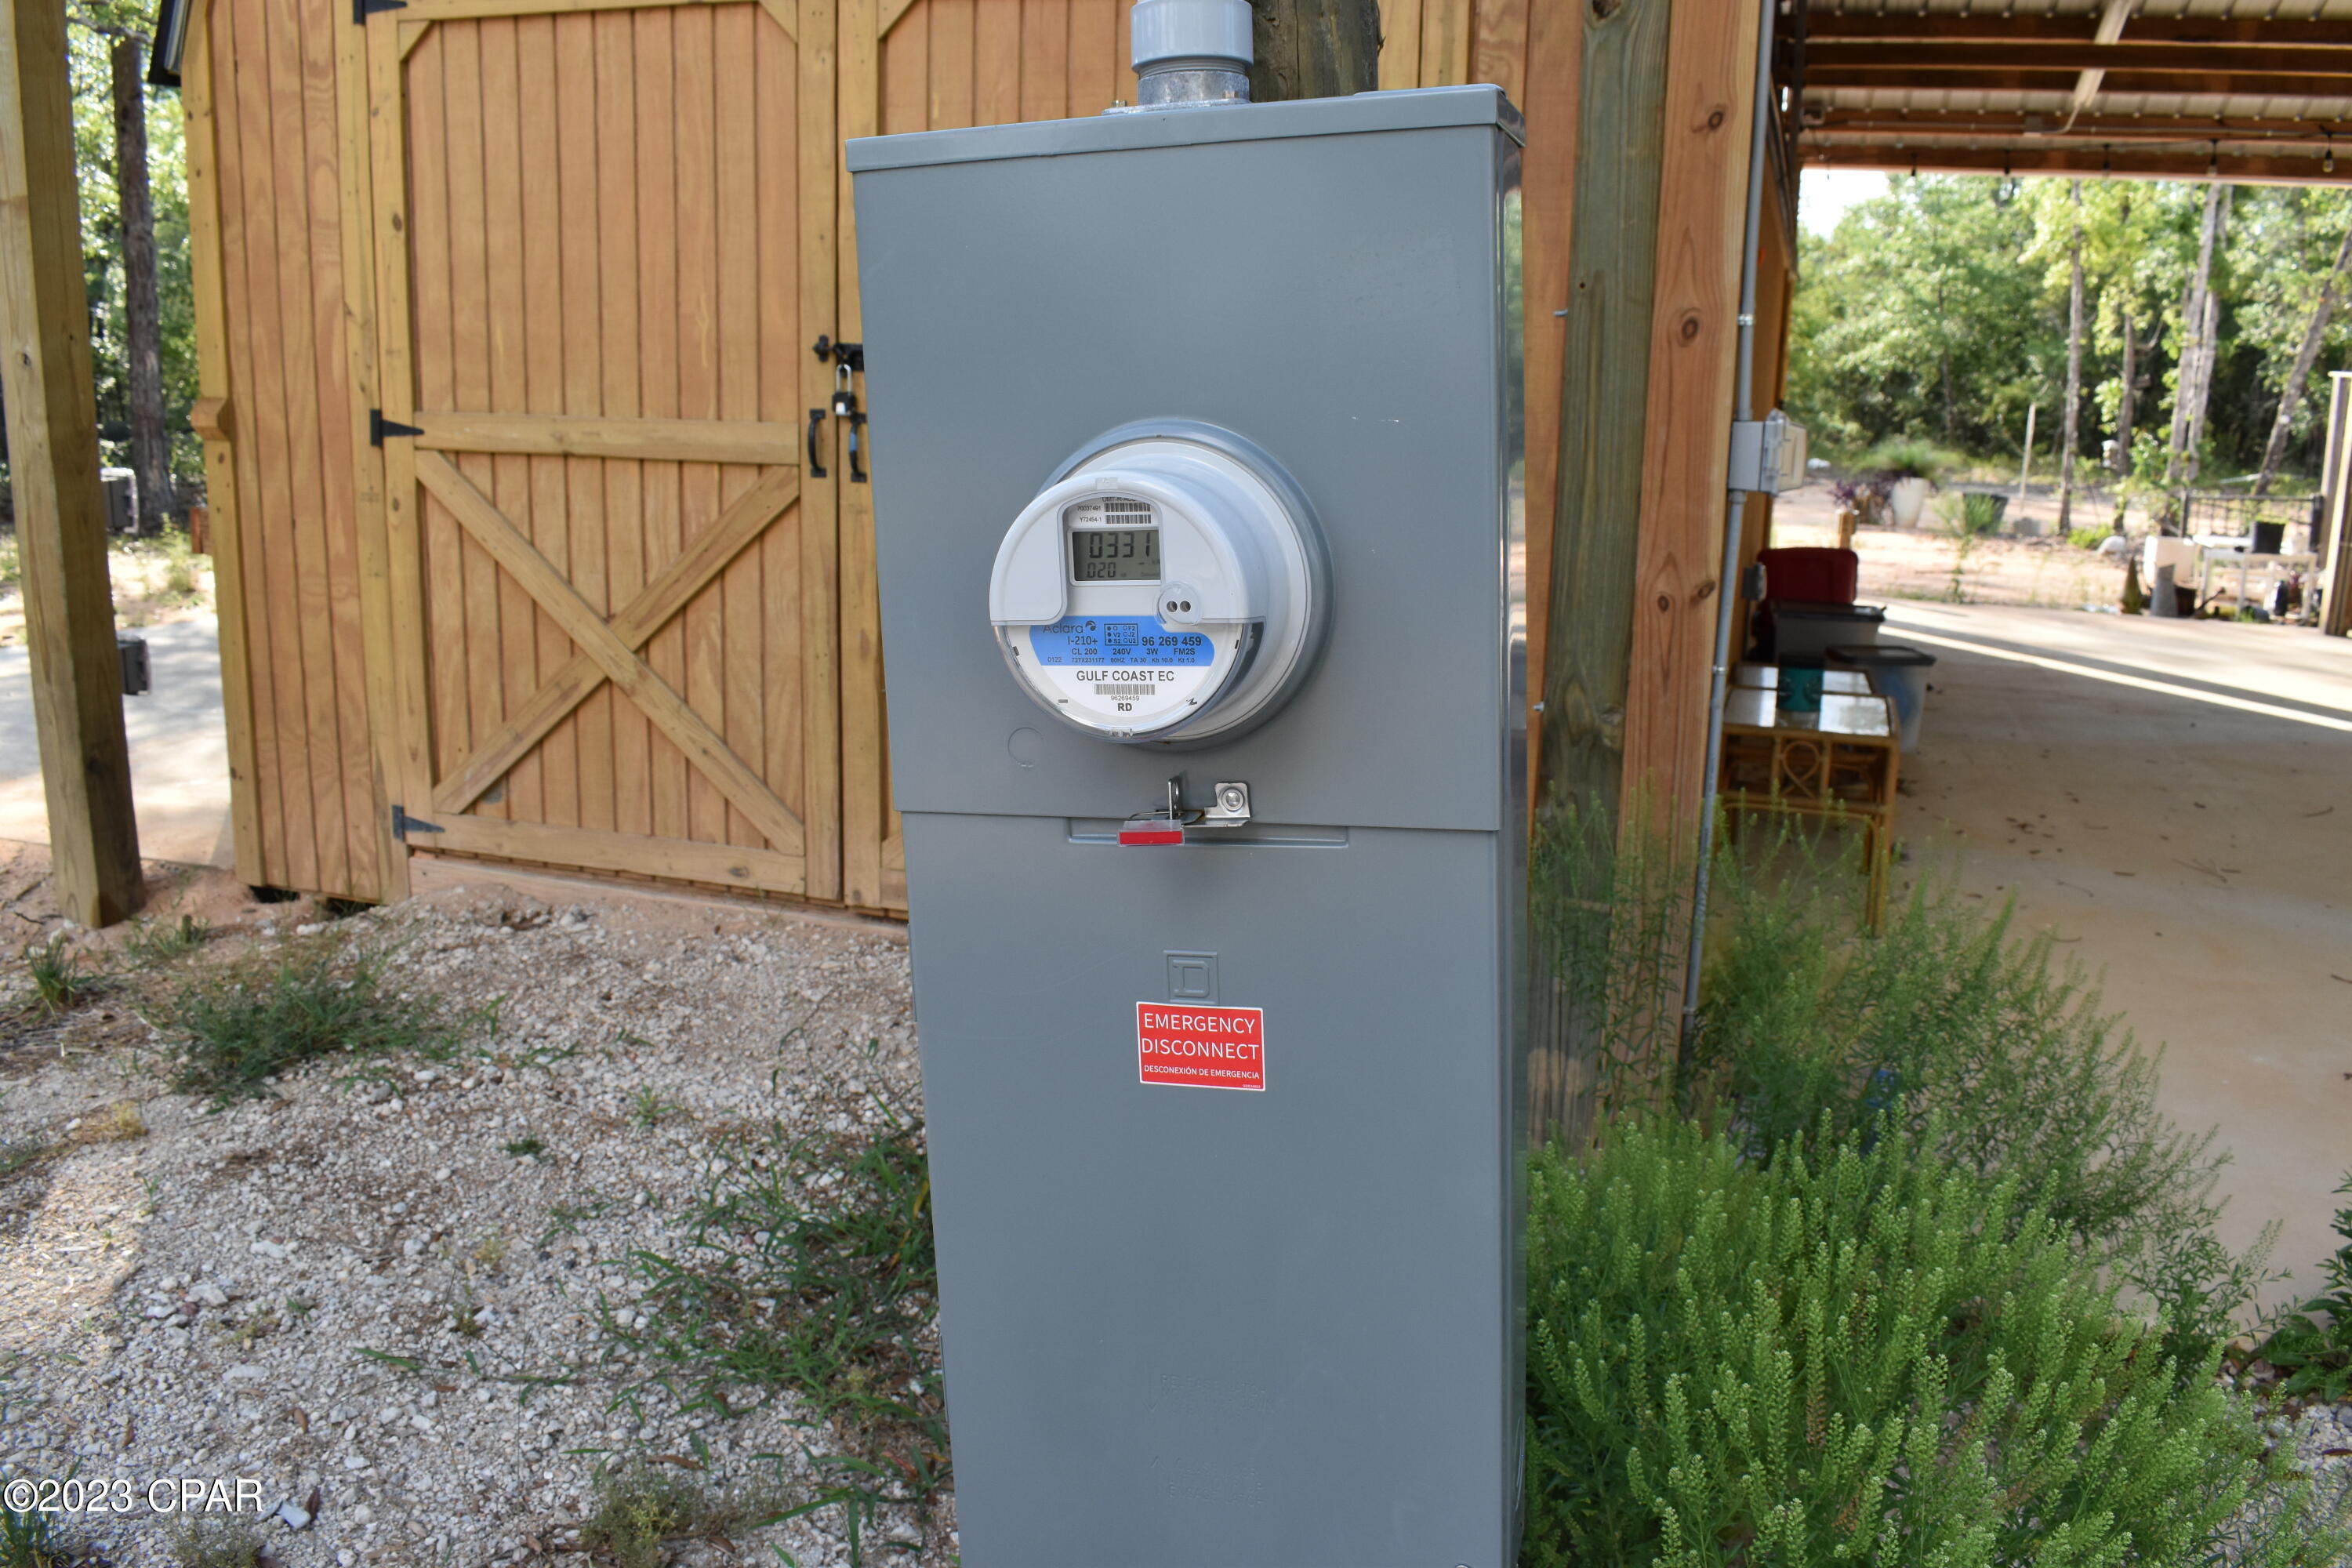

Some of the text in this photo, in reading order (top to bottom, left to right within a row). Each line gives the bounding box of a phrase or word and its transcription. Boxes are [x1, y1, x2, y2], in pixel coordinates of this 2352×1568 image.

[1089, 532, 1151, 559] 0331
[1087, 562, 1116, 579] 020
[1043, 624, 1083, 633] Aclara
[1068, 636, 1098, 645] I-210+
[1142, 636, 1202, 646] 96 269 459
[1076, 670, 1175, 682] GULF COAST EC
[1118, 702, 1133, 712] RD
[1144, 1012, 1255, 1034] EMERGENCY
[1142, 1037, 1259, 1060] DISCONNECT
[1144, 1065, 1197, 1076] DESCONEXIÓN
[1210, 1069, 1260, 1080] EMERGENCIA
